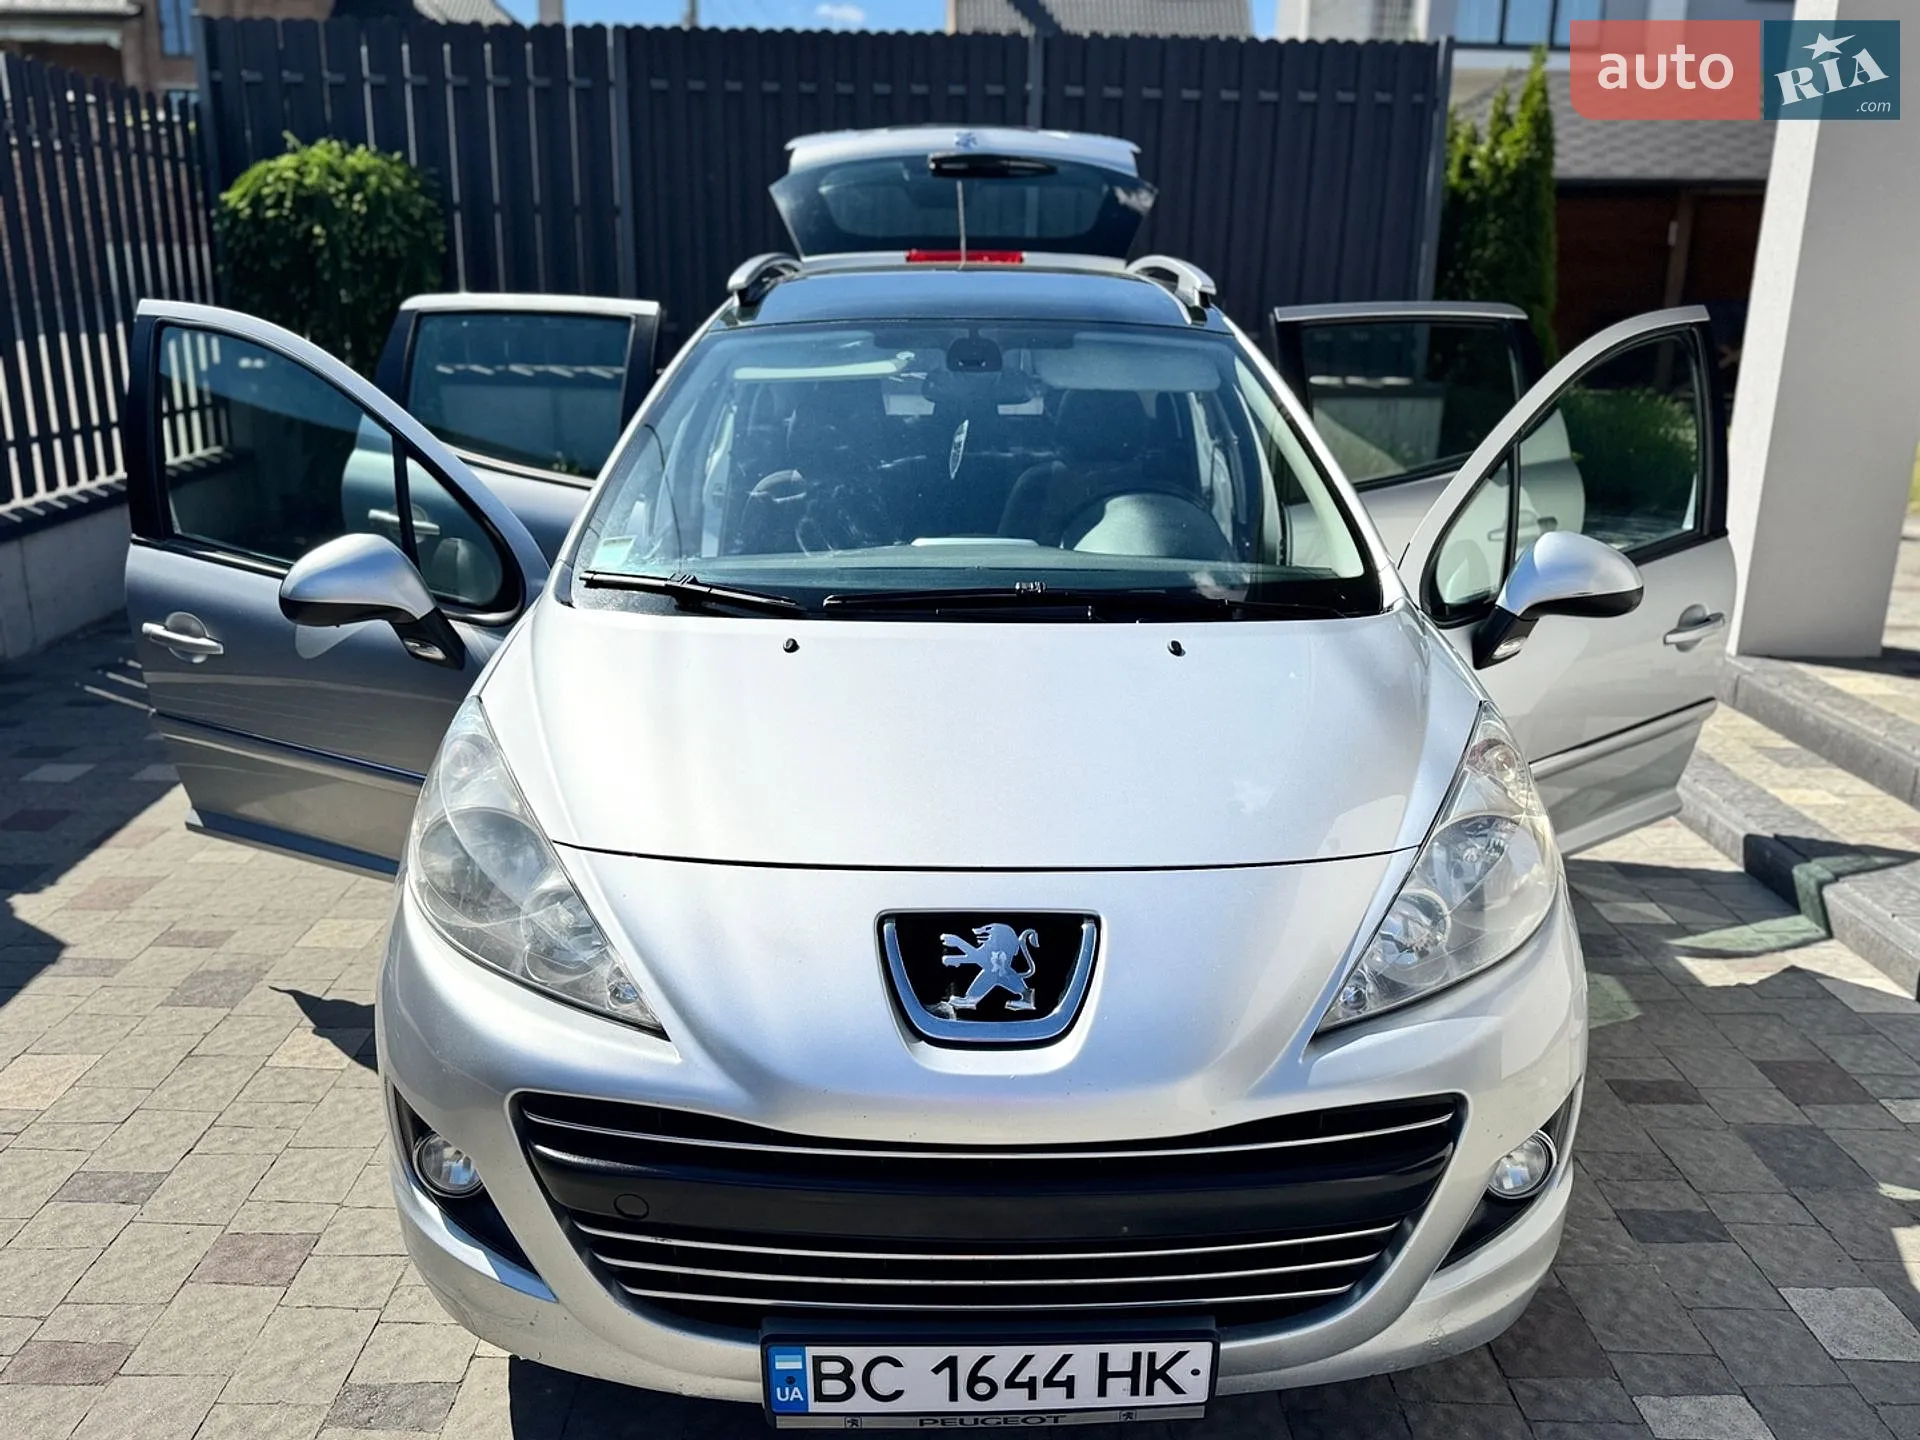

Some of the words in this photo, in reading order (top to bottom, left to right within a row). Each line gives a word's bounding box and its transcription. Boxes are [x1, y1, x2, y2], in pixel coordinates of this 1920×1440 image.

[812, 1354, 904, 1403] BC
[930, 1353, 1075, 1402] 1644
[1098, 1350, 1190, 1398] HK
[776, 1386, 804, 1401] UA
[918, 1413, 1067, 1428] PEUGEOT
